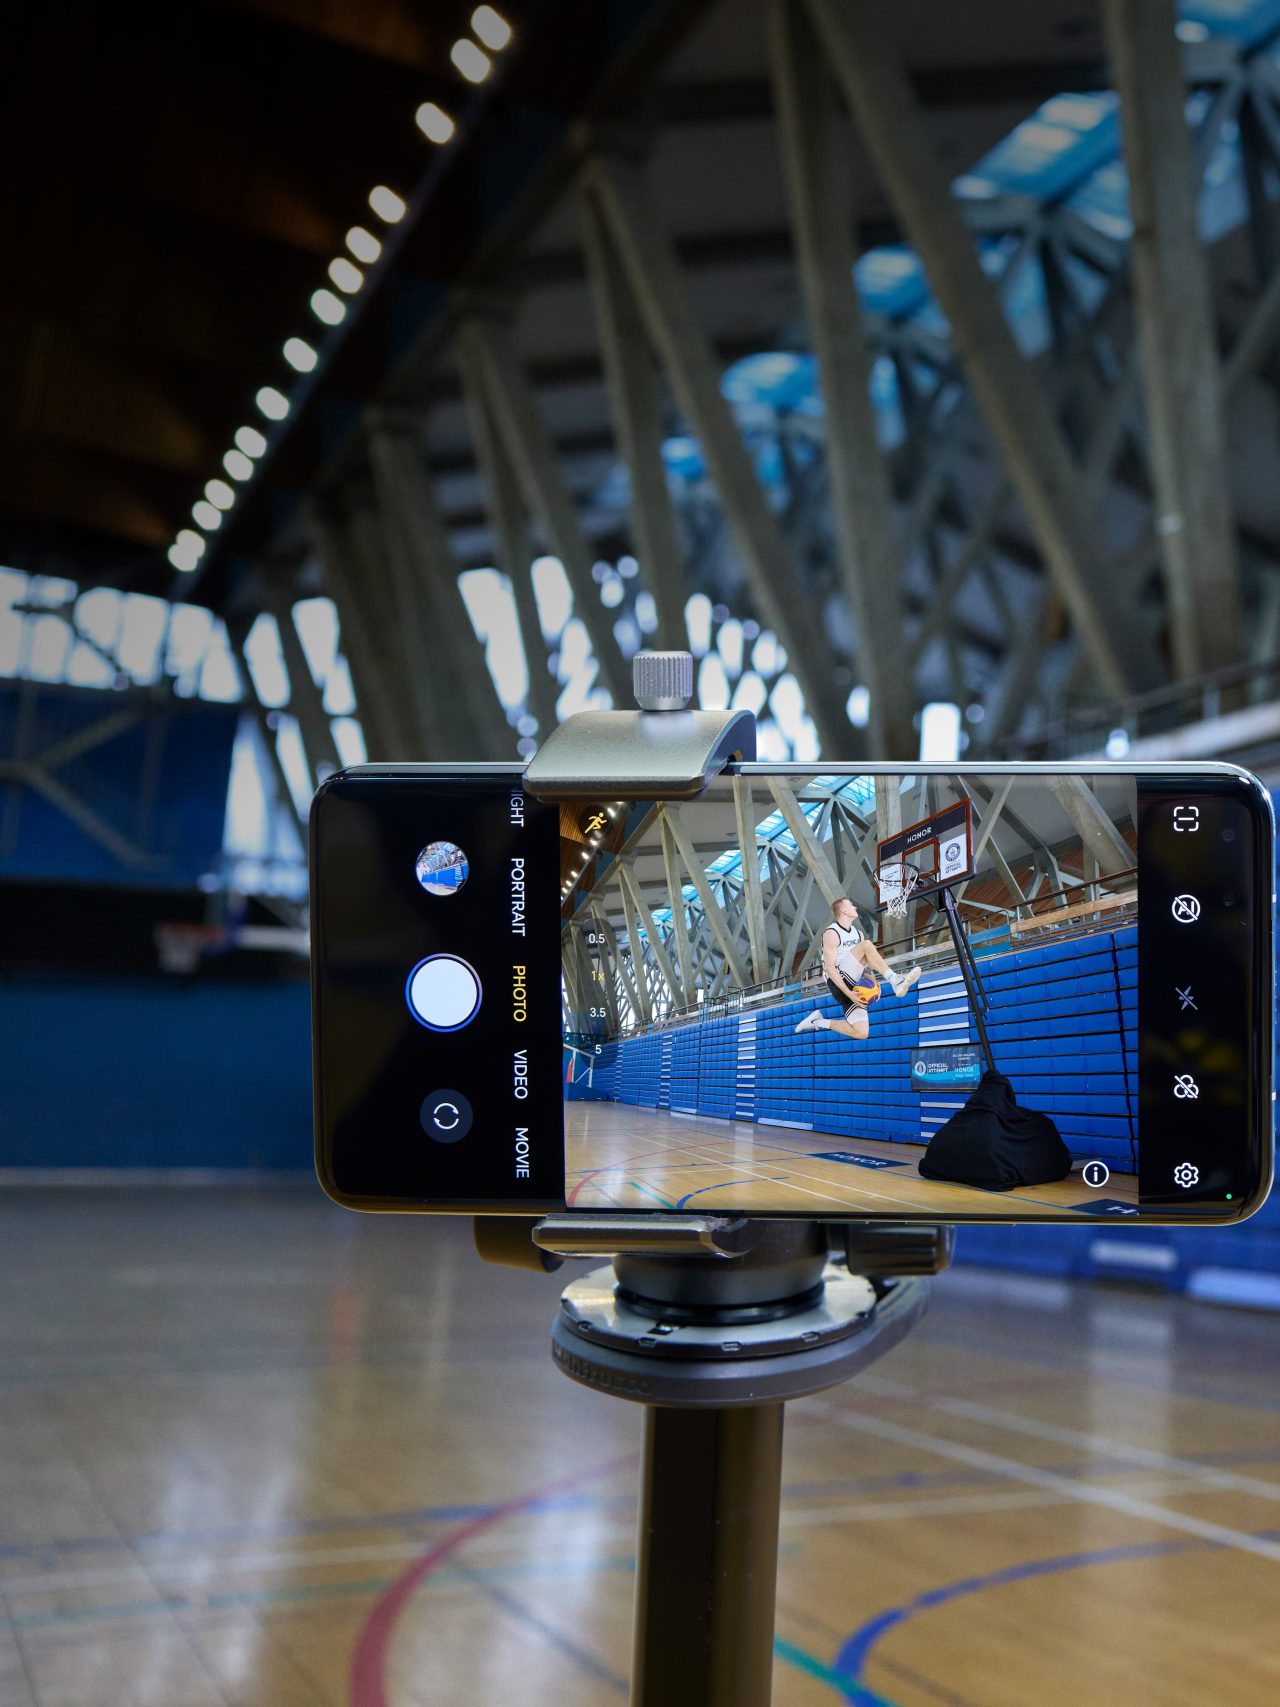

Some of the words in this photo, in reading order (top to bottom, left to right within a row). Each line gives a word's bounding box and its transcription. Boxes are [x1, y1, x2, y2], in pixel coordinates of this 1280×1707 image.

[907, 826, 932, 844] HONOR
[511, 858, 526, 937] PORTRAIT
[588, 933, 605, 944] 0.5
[591, 970, 605, 981] 1x
[512, 965, 527, 1022] PHOTO
[590, 1007, 606, 1018] 3.5
[595, 1044, 602, 1054] 5
[513, 1049, 529, 1100] VIDEO
[515, 1127, 530, 1178] MOVIE
